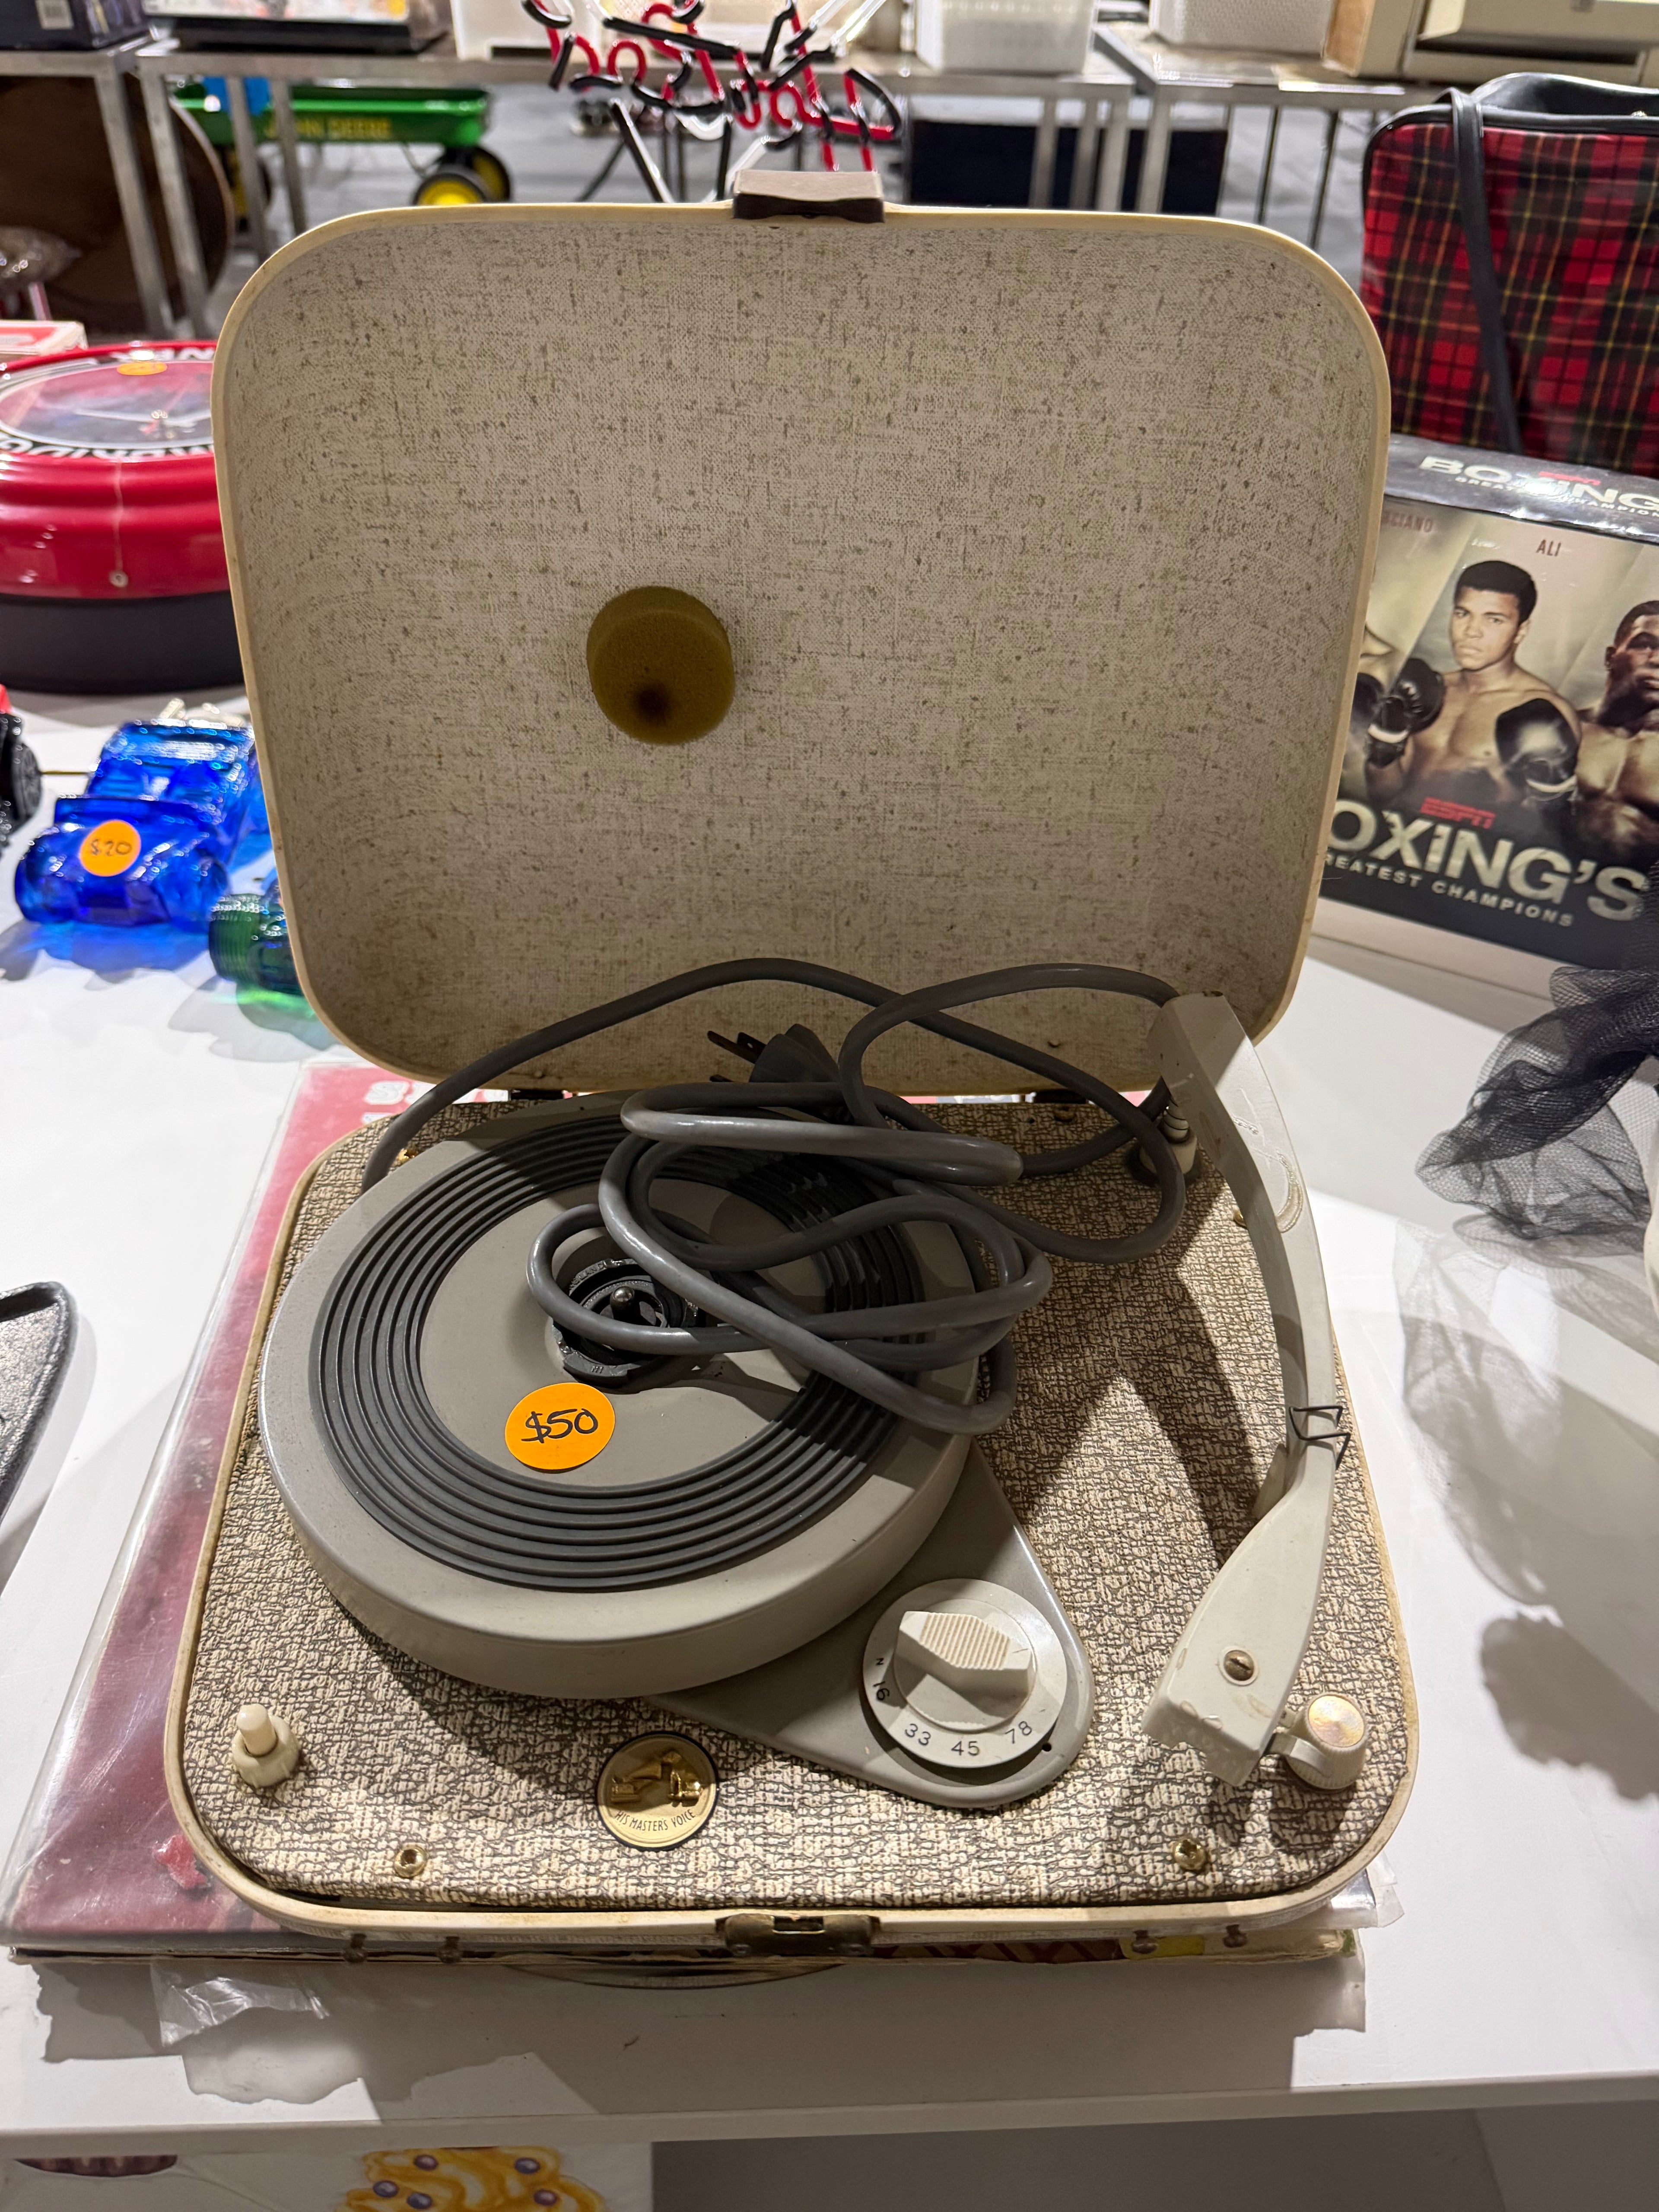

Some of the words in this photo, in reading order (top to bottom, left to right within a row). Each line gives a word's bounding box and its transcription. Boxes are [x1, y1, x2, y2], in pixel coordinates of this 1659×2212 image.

[1536, 539, 1562, 557] ALI
[1420, 797, 1497, 830] ESPN
[90, 839, 133, 857] $20
[1431, 880, 1574, 928] CHAMPIONS
[521, 1408, 599, 1444] $50
[872, 1681, 890, 1701] 16
[904, 1723, 931, 1746] 33
[950, 1740, 980, 1756] 45
[1004, 1721, 1033, 1744] 78
[614, 1810, 630, 1825] HIS
[671, 1808, 696, 1827] VOICE
